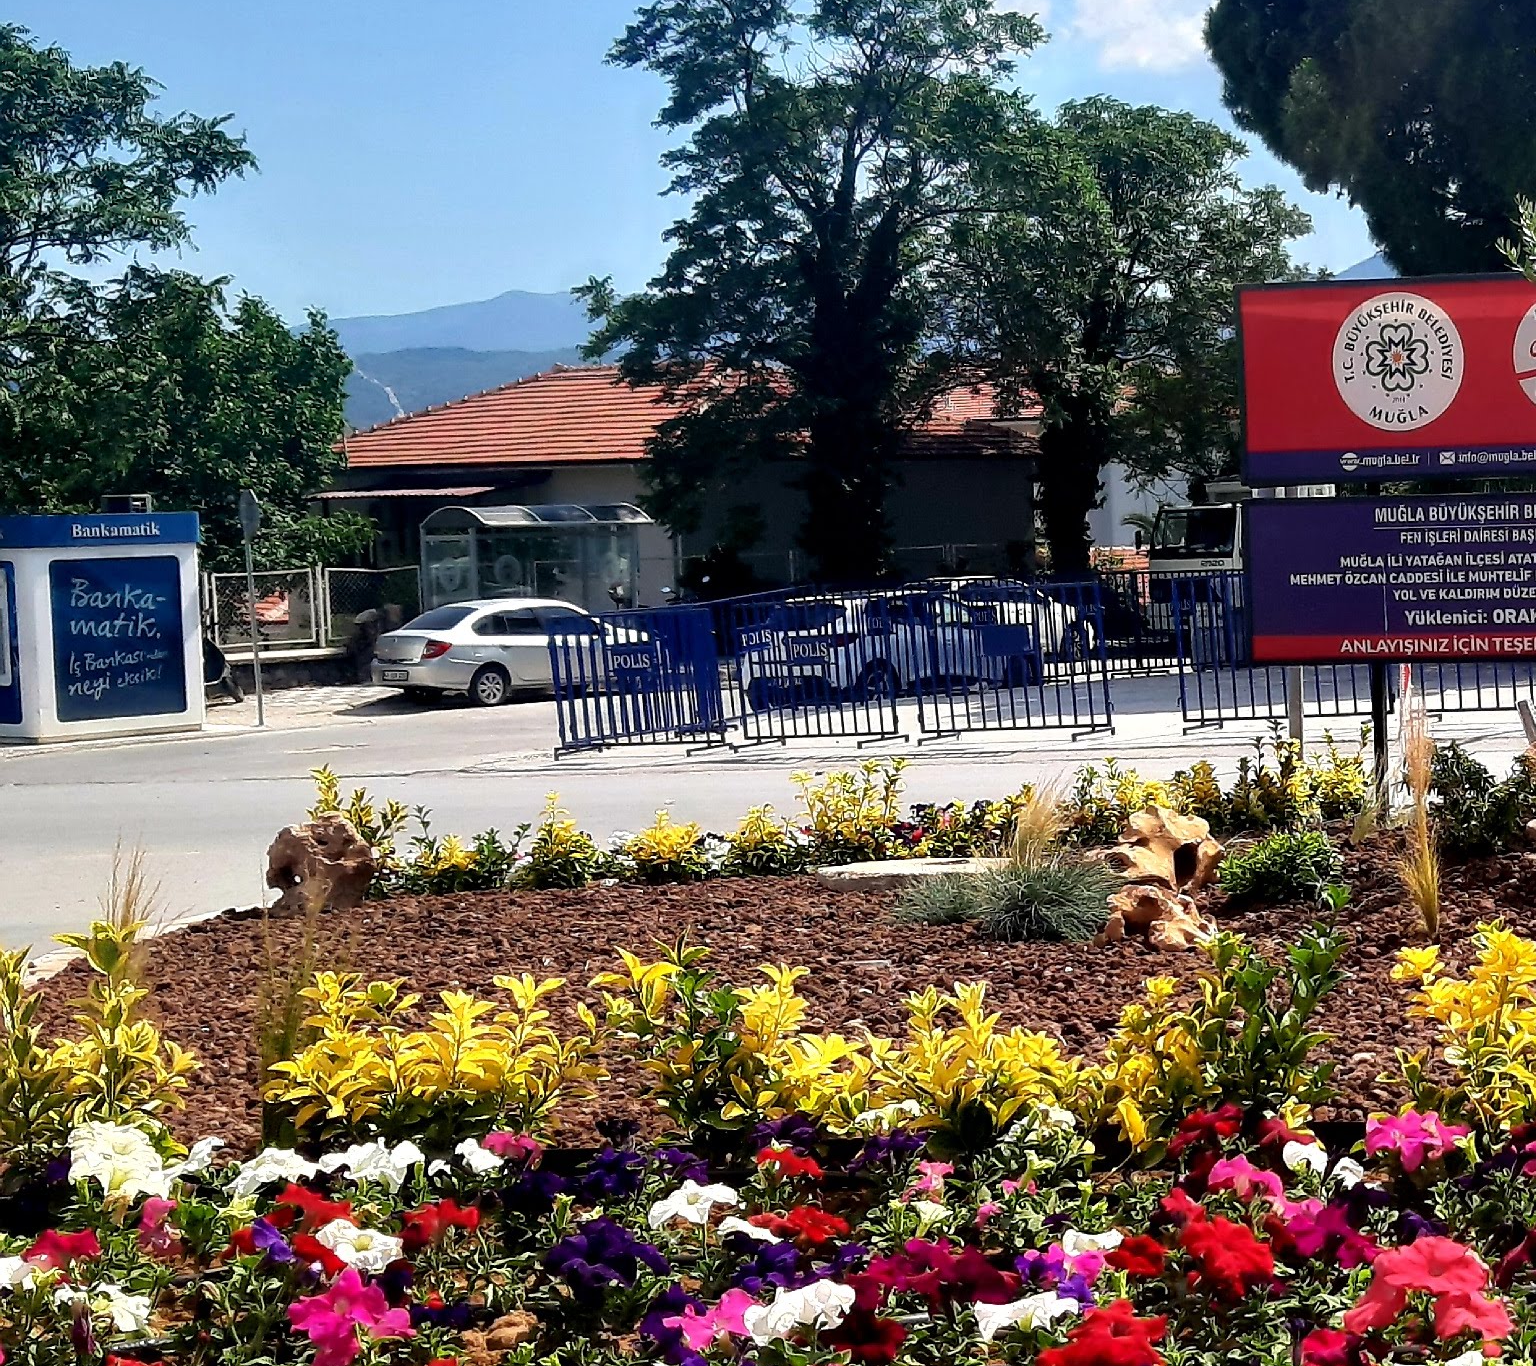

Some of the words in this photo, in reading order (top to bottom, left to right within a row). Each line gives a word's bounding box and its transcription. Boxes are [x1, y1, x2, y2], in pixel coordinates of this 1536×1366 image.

[1344, 299, 1415, 352] BÜYÜKŞEHİR
[1369, 405, 1429, 424] MUĞLA
[1374, 505, 1425, 523] MUĞLA
[1428, 502, 1519, 524] BÜYÜKŞEHİR
[71, 520, 161, 538] Bankamatik
[1400, 531, 1422, 544] FEN
[1424, 528, 1461, 546] İŞLERİ
[1463, 526, 1509, 543] DAİRESİ
[1340, 553, 1385, 568] MUĞLA
[1387, 553, 1403, 567] İLİ
[1405, 551, 1462, 567] YATAĞAN
[1465, 550, 1505, 568] İLÇESİ
[1290, 573, 1342, 586] MEHMET
[1345, 571, 1386, 584] ÖZCAN
[1389, 568, 1443, 584] CADDESİ
[1446, 569, 1466, 583] İLE
[1468, 567, 1532, 583] MUHTELİF
[70, 577, 167, 610] Banka-
[1393, 590, 1418, 601] YOL
[1420, 589, 1437, 601] VE
[1439, 588, 1500, 600] KALDIRIM
[70, 611, 161, 639] matik.
[1404, 609, 1488, 626] Yüklenici:
[1340, 637, 1450, 656] ANLAYIŞINIZ
[1453, 635, 1489, 655] İÇİN
[68, 671, 110, 701] neyi
